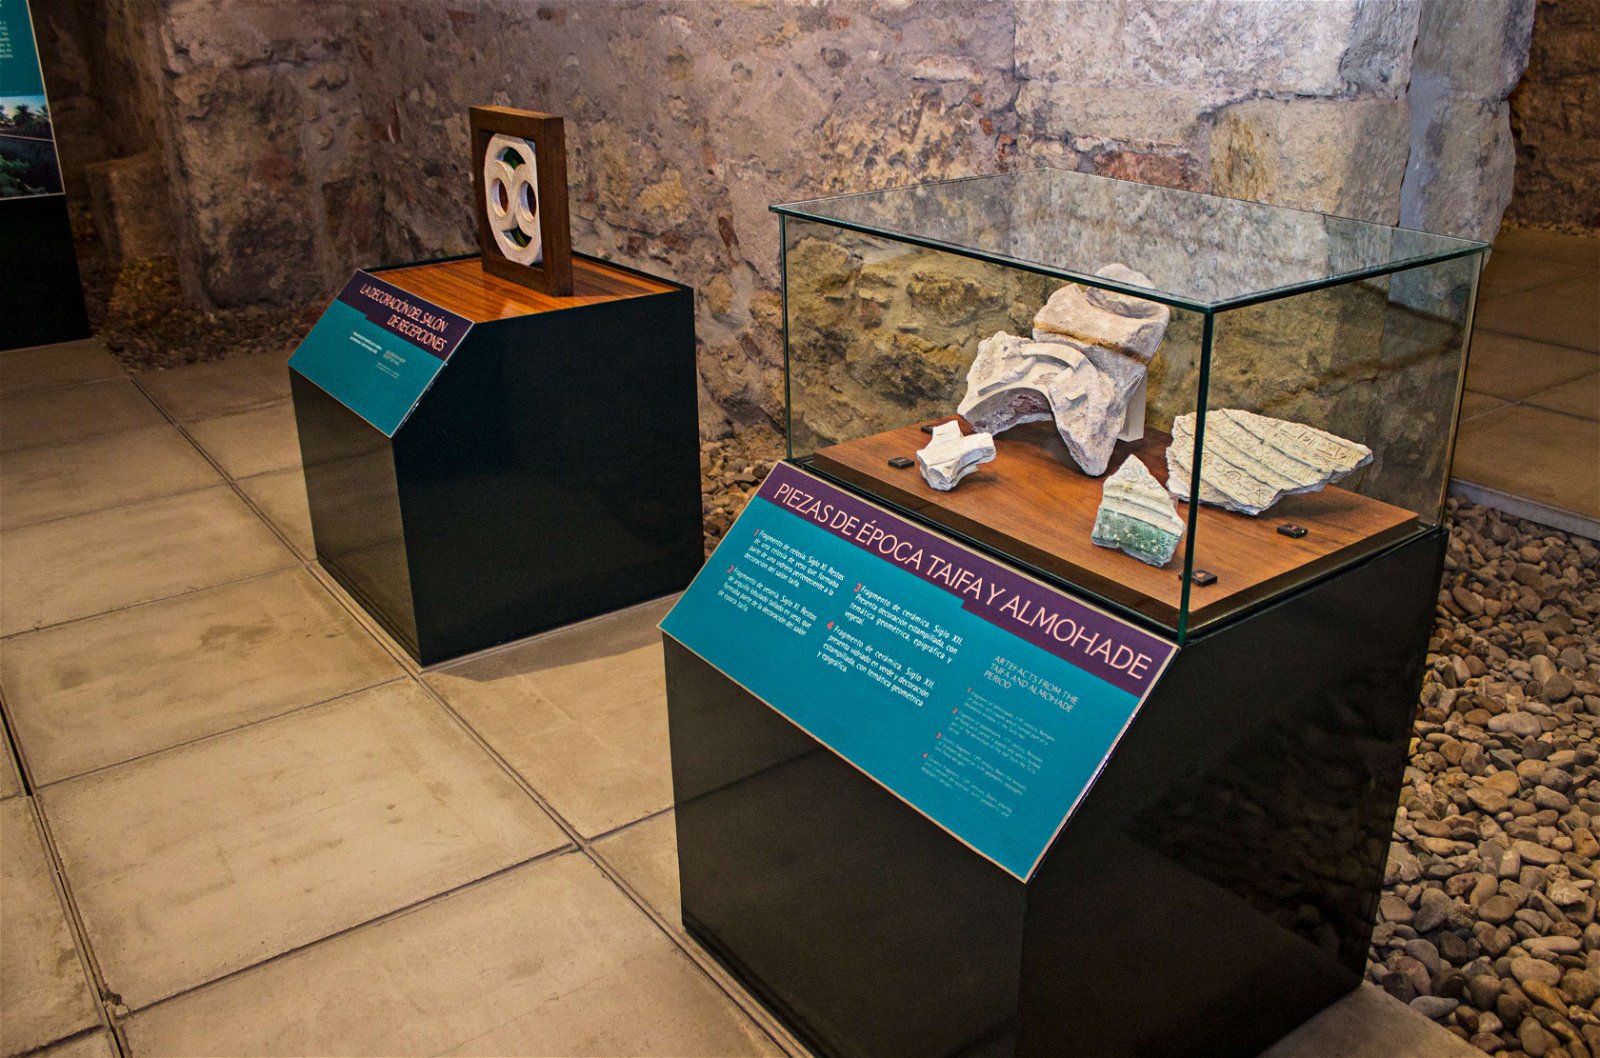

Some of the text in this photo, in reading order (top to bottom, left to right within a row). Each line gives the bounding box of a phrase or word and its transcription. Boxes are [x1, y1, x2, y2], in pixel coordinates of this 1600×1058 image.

[360, 284, 448, 332] LA DECORACIÓN DEL SALÓN
[387, 314, 401, 328] DE
[396, 319, 448, 352] RECEPCIONES
[759, 530, 783, 547] Fragmento
[807, 556, 820, 568] Siglo
[828, 567, 845, 581] Restos
[807, 568, 817, 576] que
[818, 572, 839, 589] formaba
[727, 565, 735, 574] 2
[733, 567, 757, 585] Fragmento
[780, 595, 793, 607] Siglo
[800, 606, 817, 621] Restos
[773, 483, 1152, 680] PIEZAS DE ÉPOCA TAIFA Y ALMOHADE
[850, 602, 875, 620] temática
[876, 618, 910, 641] geométrica,
[913, 638, 945, 660] epigráfica
[854, 583, 862, 592] 3
[860, 585, 891, 607] Fragmento
[892, 604, 901, 612] de
[933, 624, 950, 639] Siglo
[951, 634, 963, 645] XII.
[855, 593, 958, 654] Presenta decoración estampillada, con
[827, 635, 850, 651] presenta
[850, 648, 871, 663] vidriado
[879, 665, 894, 677] verde
[898, 676, 929, 697] decoración
[833, 625, 864, 647] Fragmento
[865, 645, 873, 653] de
[905, 667, 922, 682] Siglo
[924, 678, 935, 688] XII.
[984, 670, 1011, 688] PERIOD
[994, 656, 1079, 704] ARTEFACTS FROM THE
[856, 663, 867, 671] con
[867, 669, 892, 687] temática
[890, 684, 924, 707] geométrica
[992, 663, 1073, 712] TAIFA AND ALMOHADE
